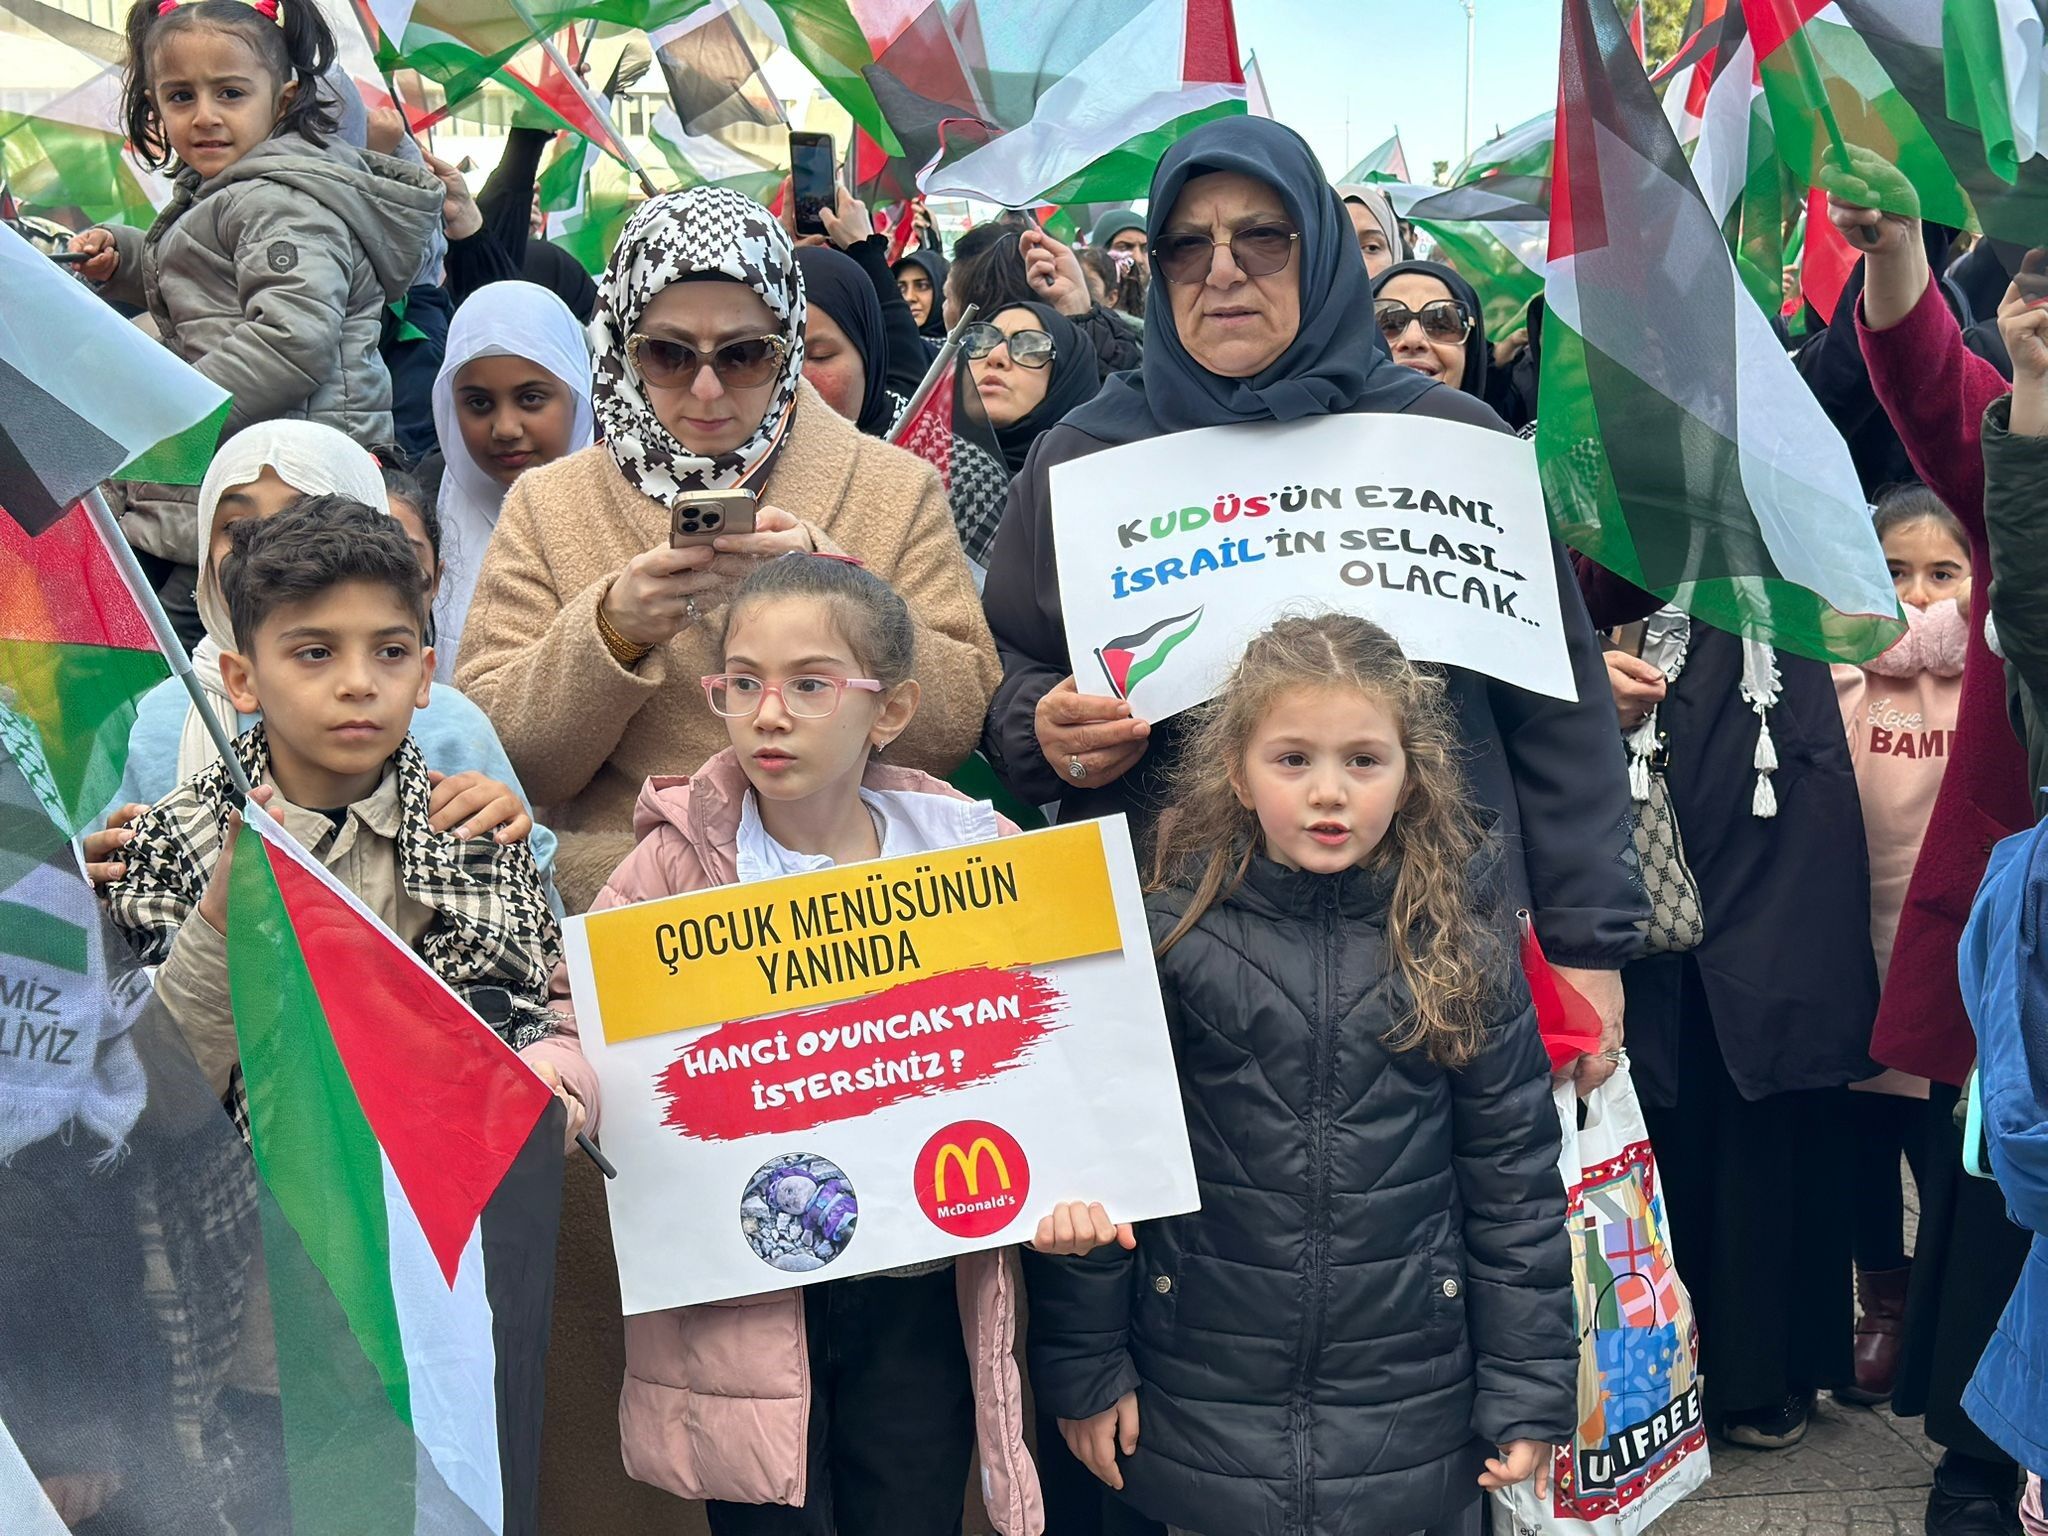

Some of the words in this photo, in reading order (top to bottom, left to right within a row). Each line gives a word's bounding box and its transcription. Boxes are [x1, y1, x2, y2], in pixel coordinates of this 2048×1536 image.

[1117, 485, 1342, 549] KUDÜS'ÜN
[1355, 485, 1505, 535] EZANI,
[1111, 527, 1326, 599] İSRAİL'İN
[1340, 560, 1540, 627] OLACAK...
[655, 903, 780, 975] ÇOCUK
[789, 857, 1019, 938] MENÜSÜNÜN
[756, 930, 920, 995] YANINDA
[683, 1030, 787, 1079] HANGİ
[937, 1193, 1016, 1219] McDonald's
[1589, 1388, 1699, 1483] UIFREE
